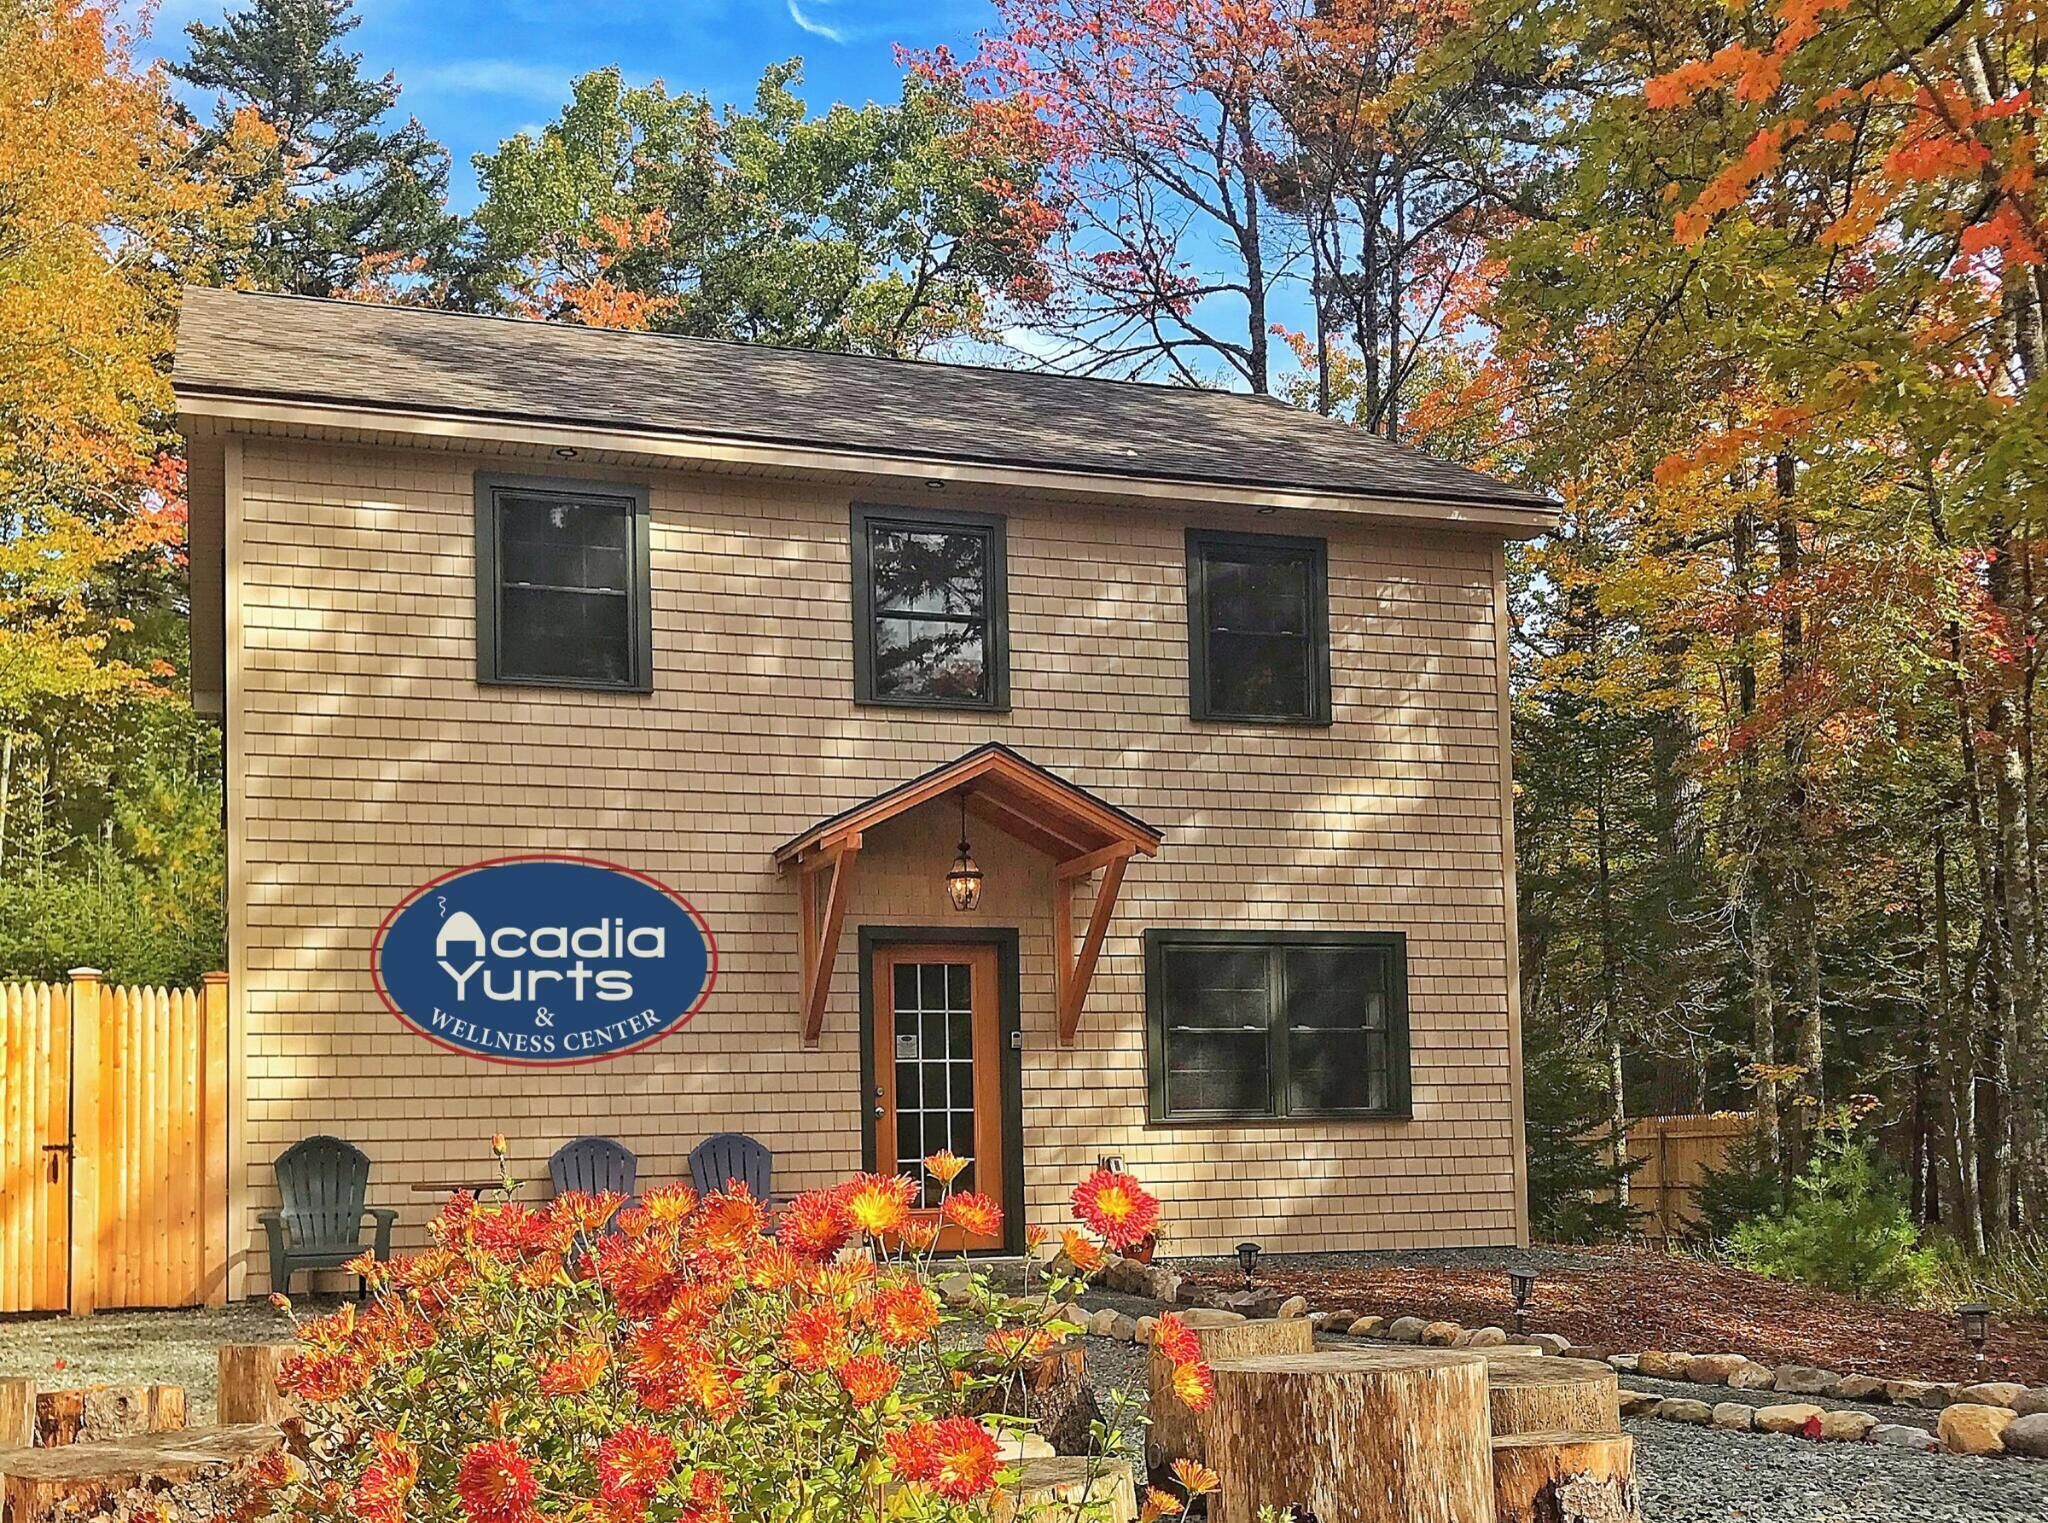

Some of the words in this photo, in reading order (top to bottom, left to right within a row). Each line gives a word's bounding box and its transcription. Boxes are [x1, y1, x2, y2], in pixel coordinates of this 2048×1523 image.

[436, 911, 665, 958] Acadia
[437, 960, 634, 1001] Yurts
[431, 1007, 556, 1053] WELLNESS
[563, 1008, 661, 1051] CENTER
[534, 1006, 555, 1027] &
